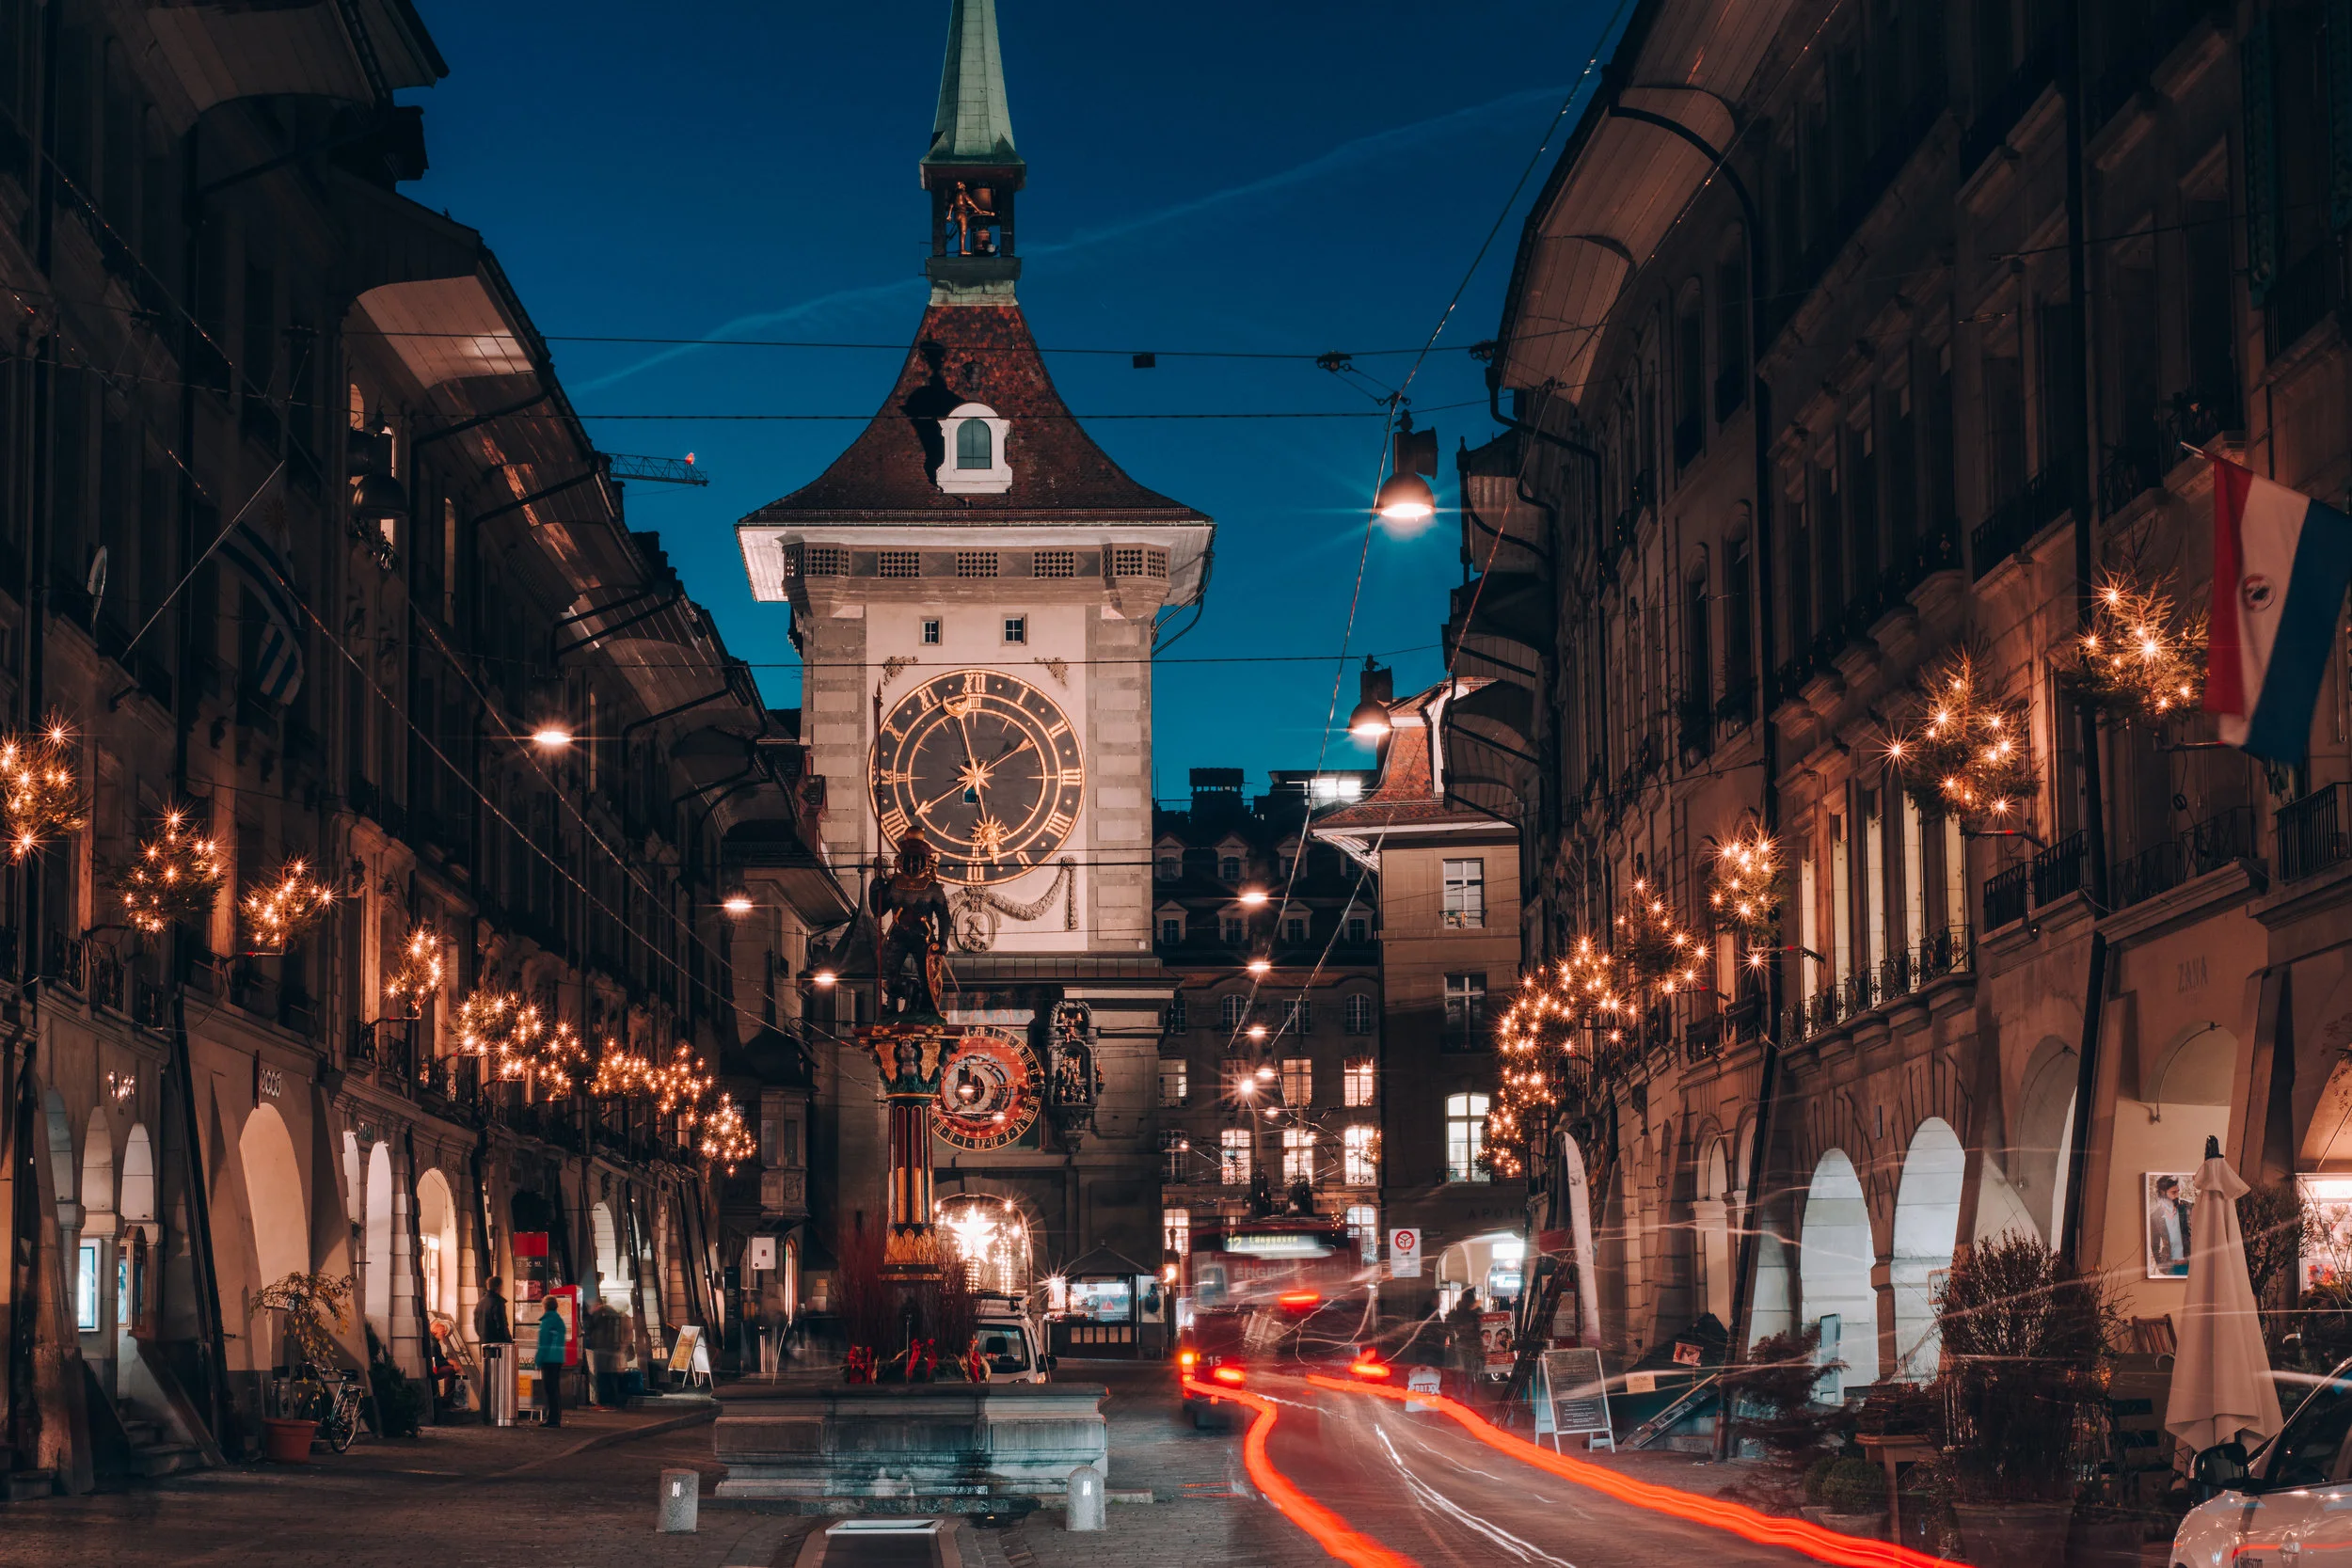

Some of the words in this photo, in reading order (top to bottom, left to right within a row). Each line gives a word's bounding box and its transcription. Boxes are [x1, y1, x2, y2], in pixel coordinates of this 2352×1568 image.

[962, 673, 986, 694] XII
[917, 686, 939, 711] XI
[884, 721, 904, 742] X
[1048, 720, 1069, 739] II
[1061, 768, 1082, 786] III
[1227, 1236, 1242, 1251] 12
[1208, 1355, 1222, 1366] 15
